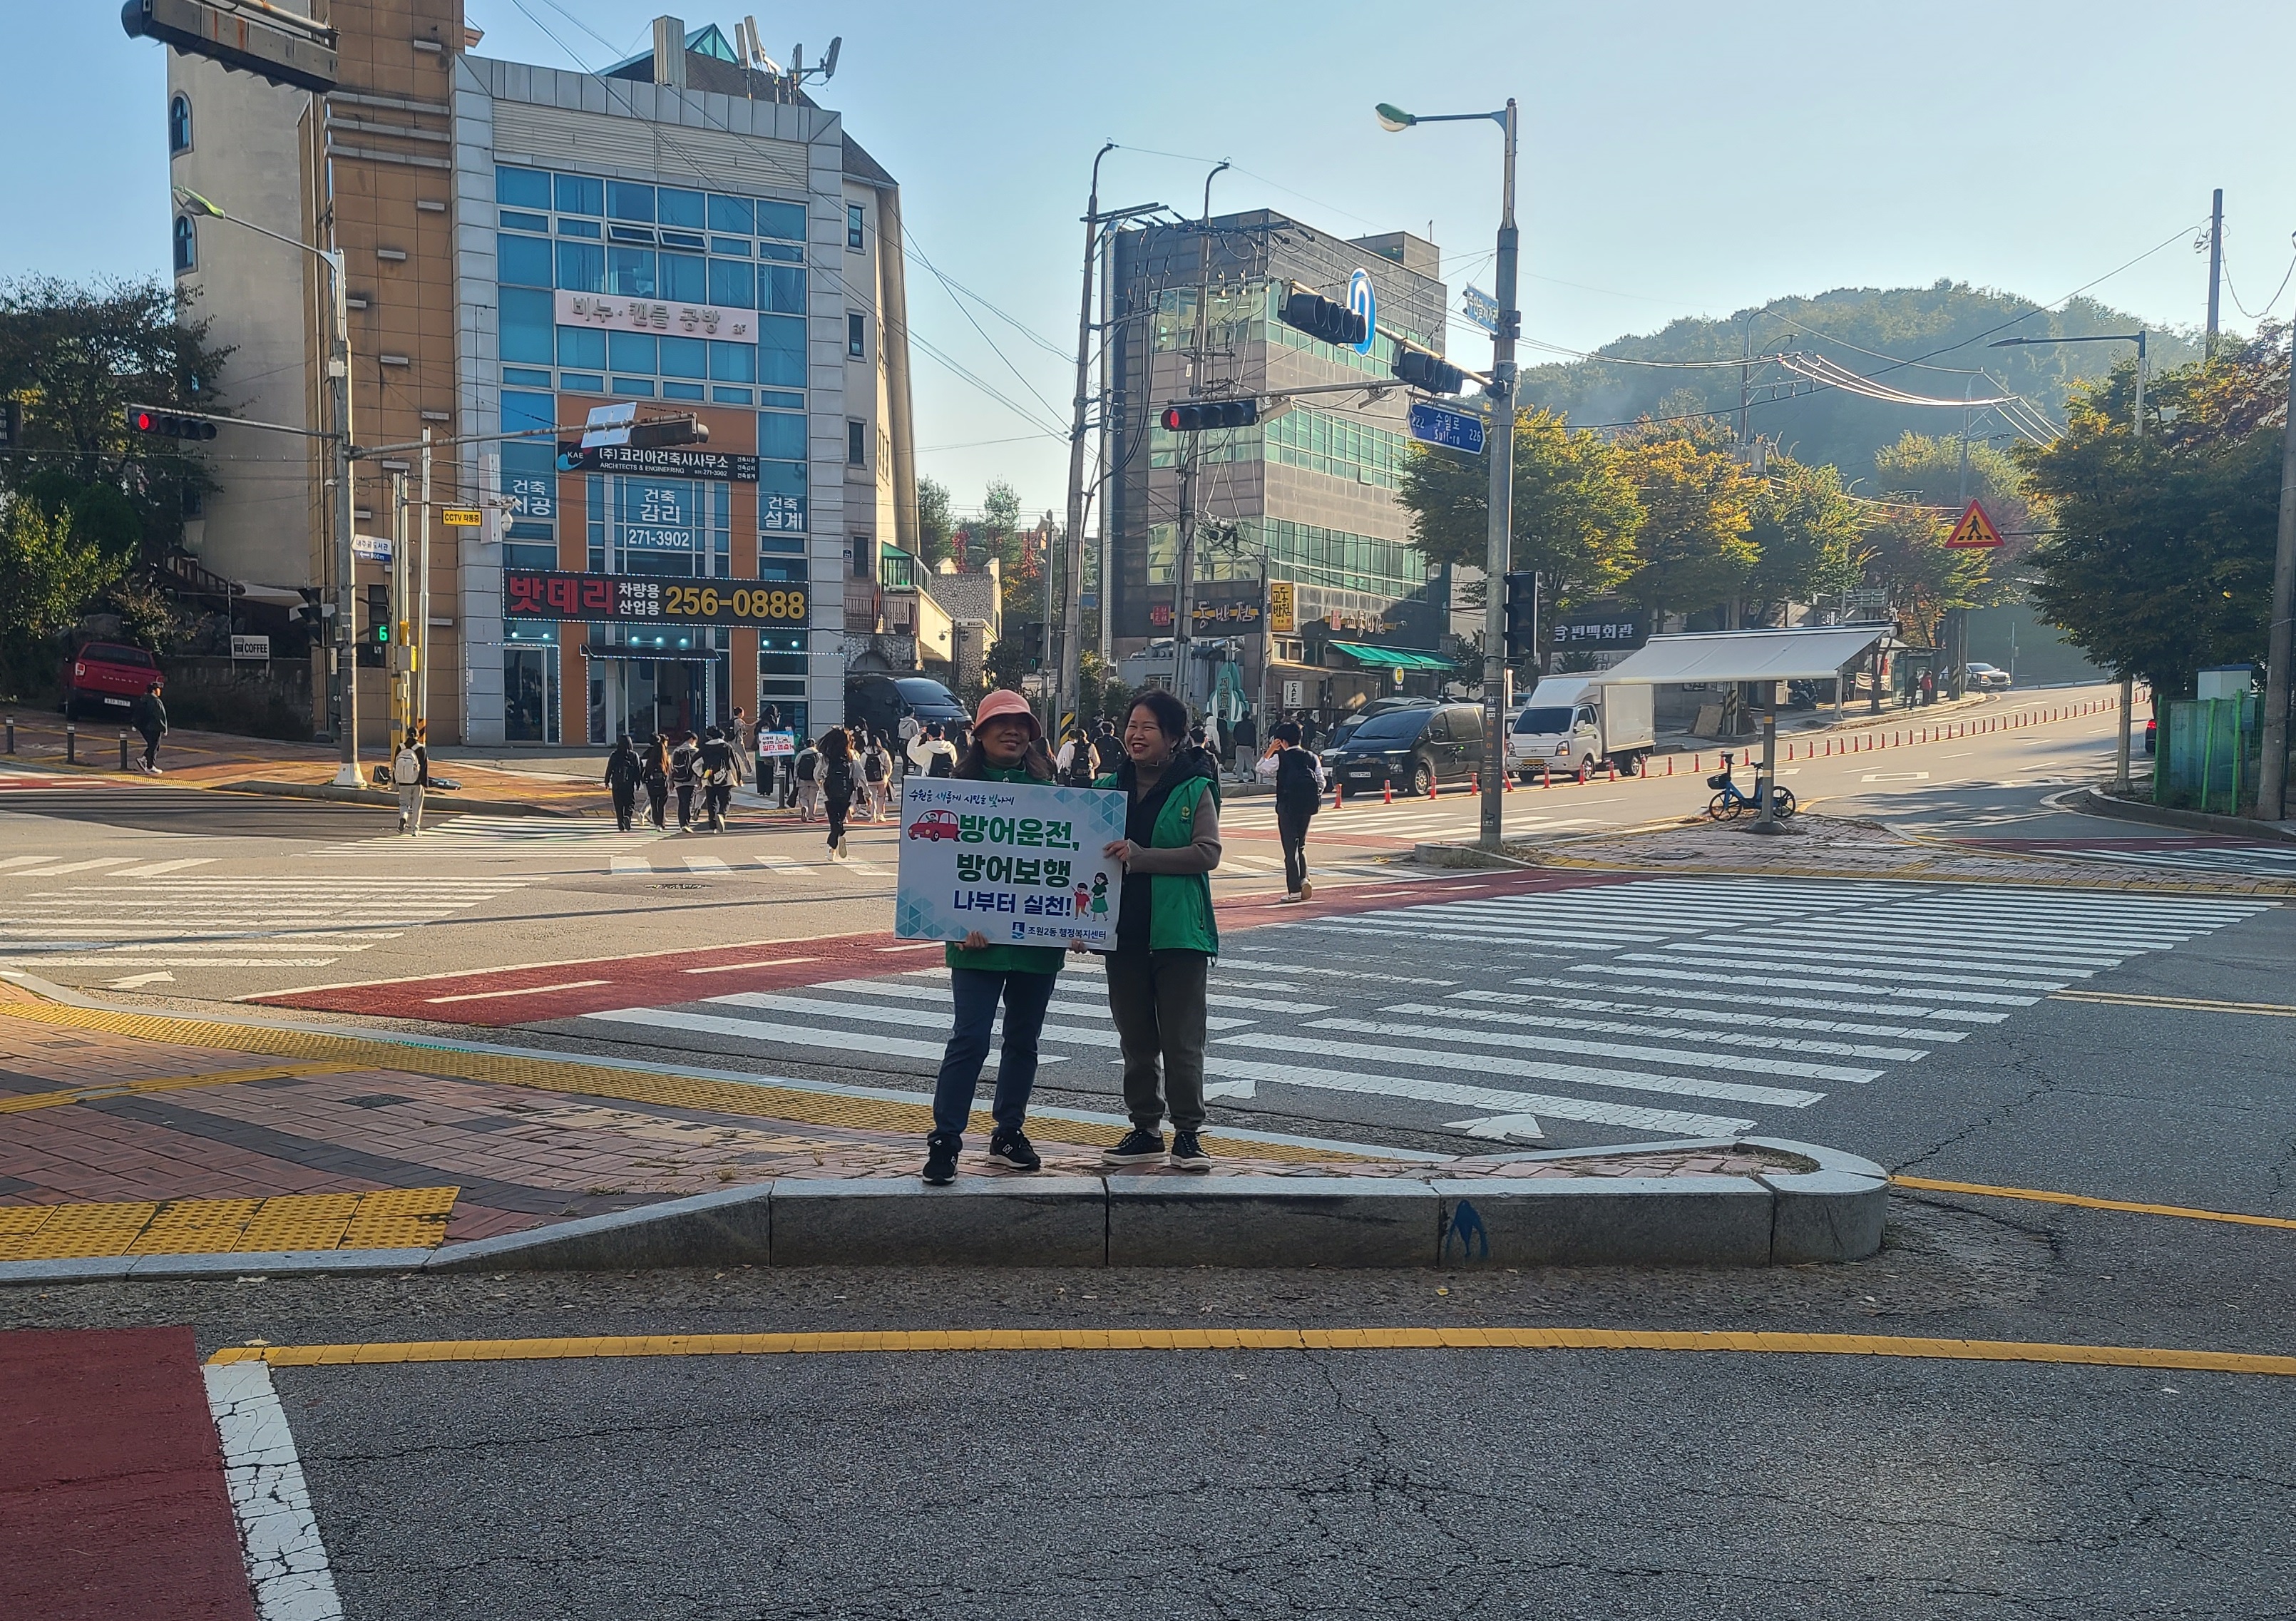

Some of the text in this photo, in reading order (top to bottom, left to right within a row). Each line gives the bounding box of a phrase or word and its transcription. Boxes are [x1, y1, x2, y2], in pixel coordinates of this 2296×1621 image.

[679, 307, 721, 334] 공방
[1412, 412, 1481, 442] 222 수일로 226
[600, 462, 637, 471] ARCHITECTS
[645, 465, 685, 474] ENGINEERING
[513, 479, 546, 496] 건축
[644, 489, 676, 504] 건축
[768, 496, 799, 511] 건축
[444, 513, 462, 521] CCTV
[640, 503, 680, 524] 감리
[764, 511, 803, 532] 설계
[628, 528, 690, 547] 271-3902
[509, 576, 806, 620] 밧데리 256-0888
[617, 582, 661, 599] 차량용
[617, 599, 661, 616] 산업용
[379, 625, 388, 641] 6
[244, 643, 268, 654] COFFEE
[909, 789, 1015, 808] 수원을 새롭게 시민을 빛나게
[959, 814, 1080, 852] 방어운전,
[956, 853, 1072, 889] 방어보행
[953, 890, 1072, 918] 나부터 실천!
[1027, 926, 1107, 940] 조원2동 행정복지센터
